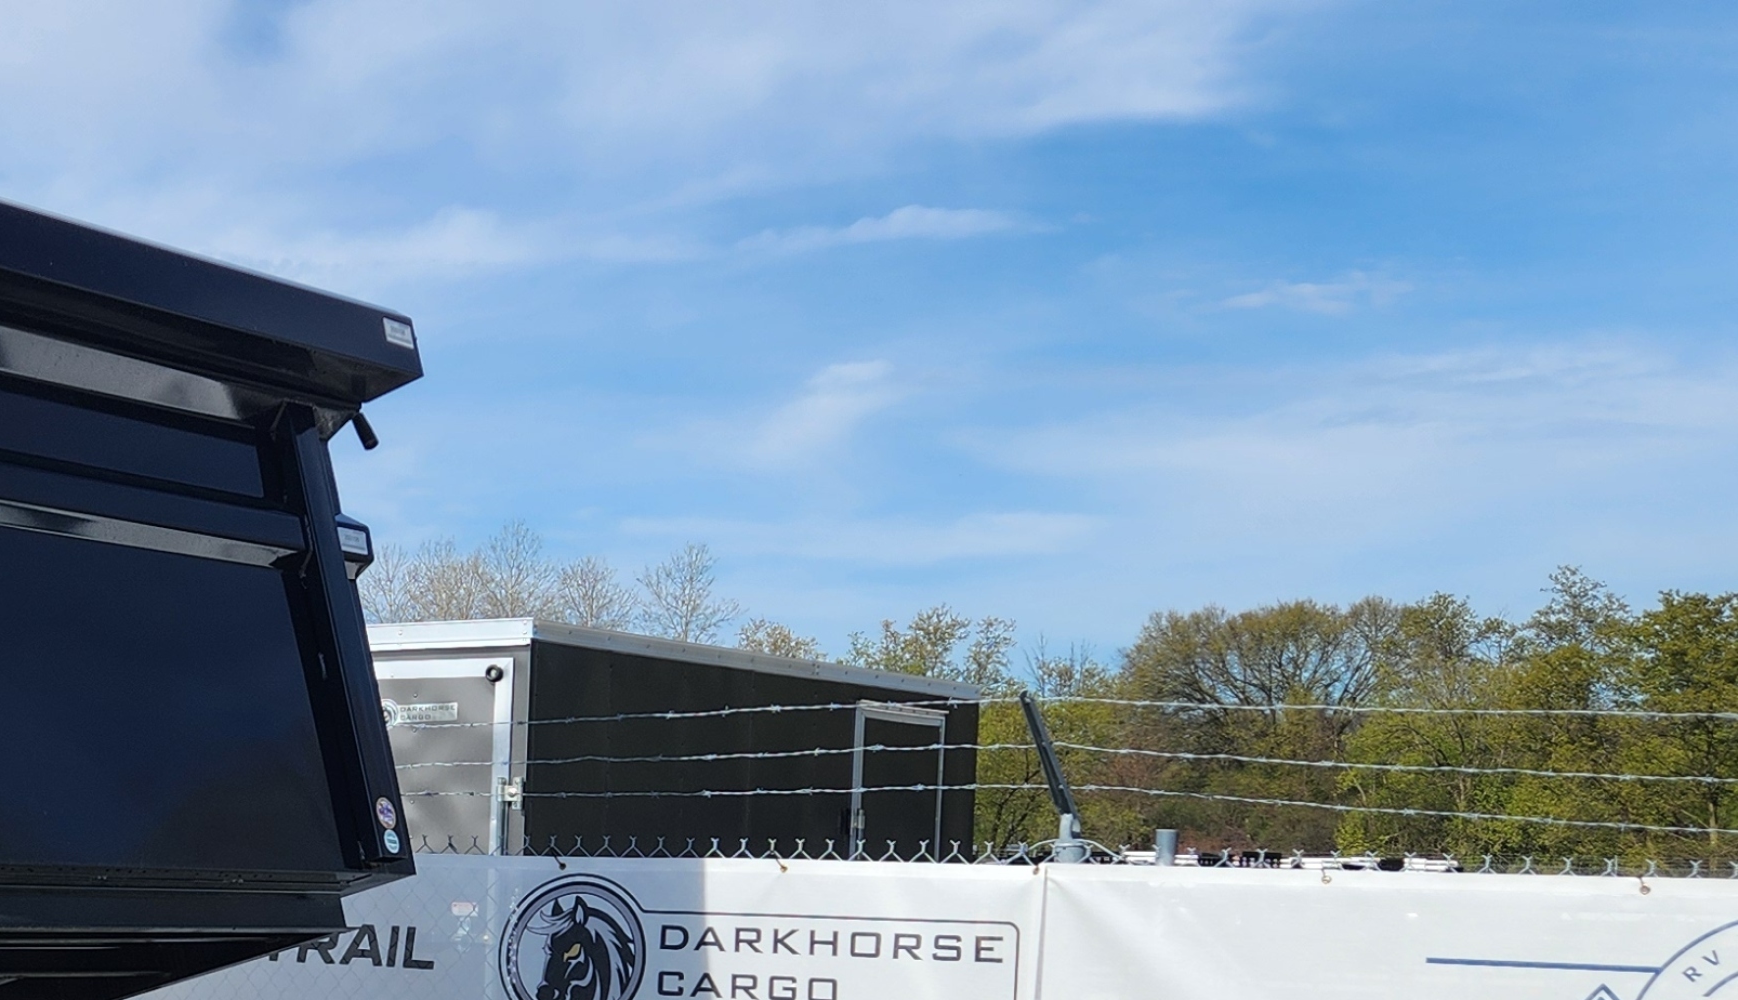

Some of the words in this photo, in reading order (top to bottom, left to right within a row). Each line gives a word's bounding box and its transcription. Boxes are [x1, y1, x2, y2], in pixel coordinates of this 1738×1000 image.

[269, 924, 435, 970] RAIL
[659, 924, 1004, 963] DARKHORSE
[1681, 950, 1721, 983] RV
